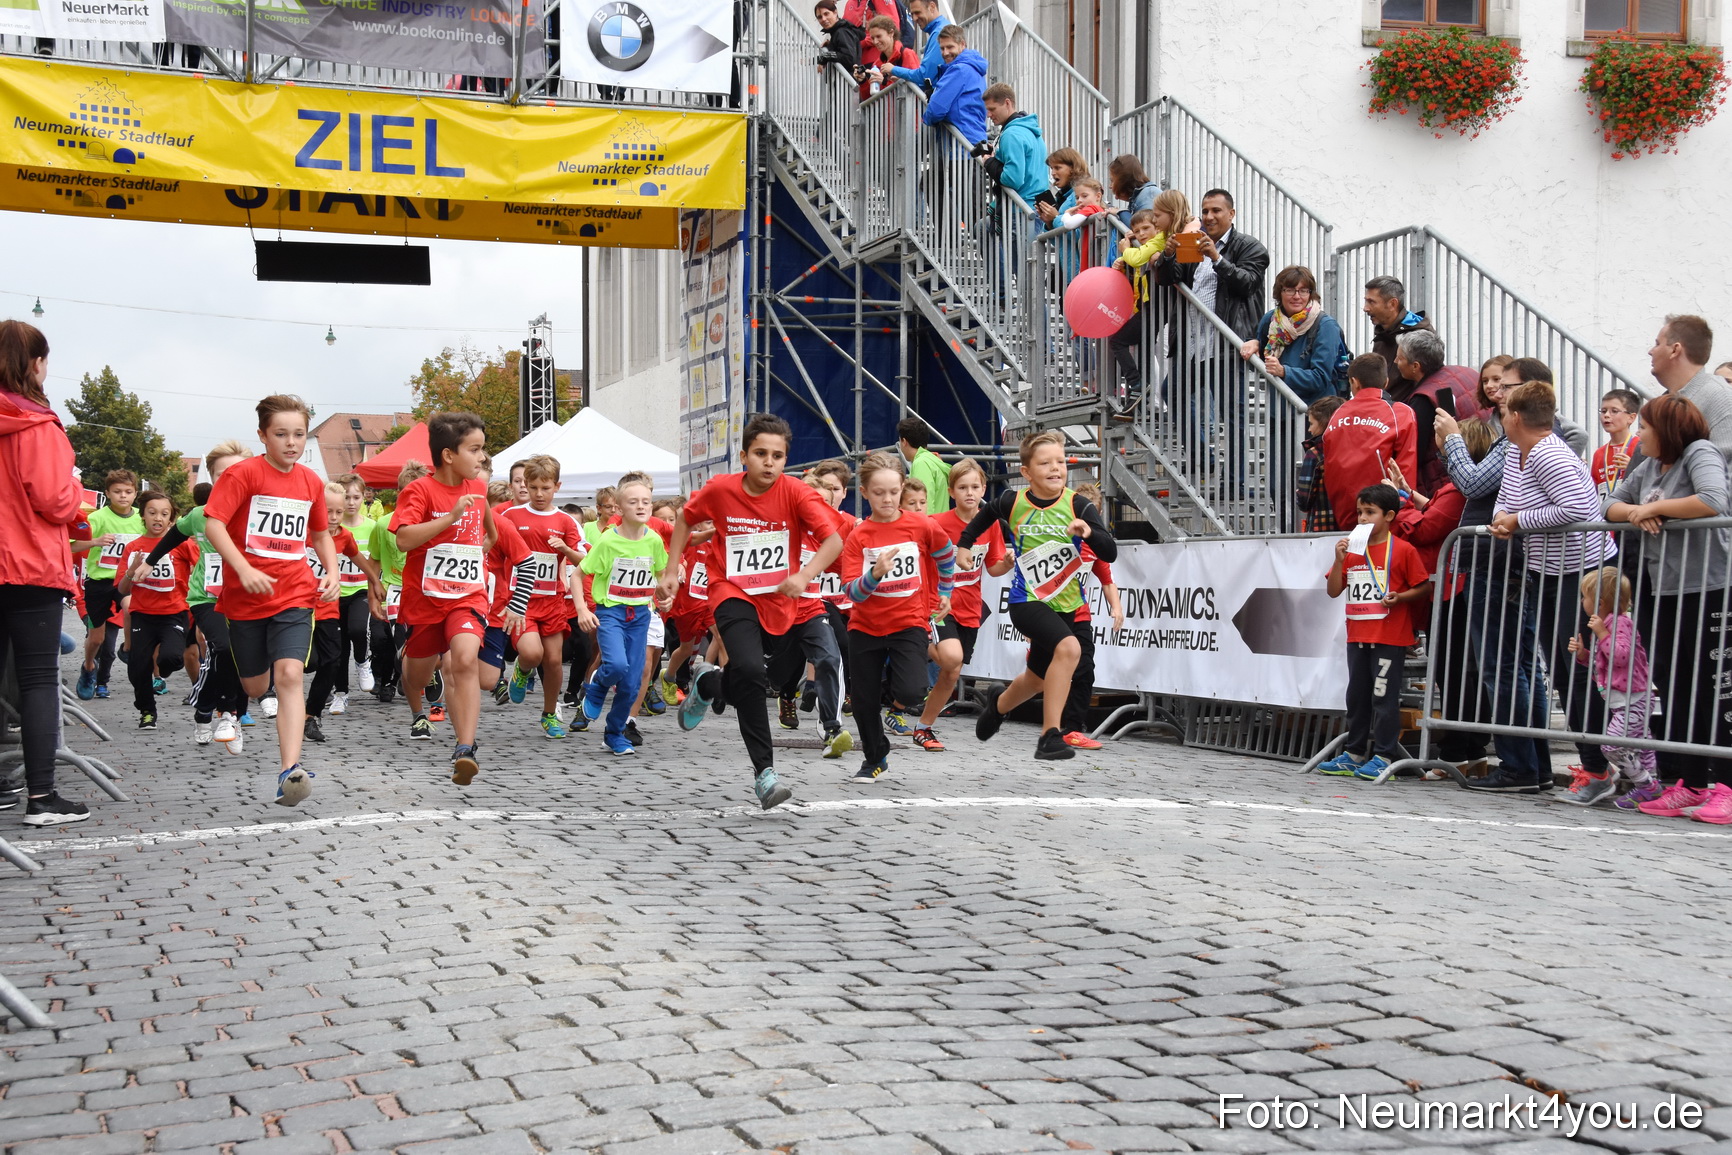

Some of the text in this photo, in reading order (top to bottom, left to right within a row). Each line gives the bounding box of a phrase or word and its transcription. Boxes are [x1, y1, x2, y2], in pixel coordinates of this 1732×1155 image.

[62, 1, 149, 16] NeuerMarkt
[216, 6, 230, 18] by
[264, 13, 310, 25] concepts
[382, 0, 466, 20] INDUSTRY
[593, 2, 651, 29] BMW
[352, 20, 506, 46] www.bockonline.de
[14, 116, 195, 148] Neumarkter Stadtlauf
[295, 109, 465, 178] ZIEL
[558, 160, 710, 176] Neumarkter Stadtlauf
[16, 168, 181, 193] Neumarkter Stadtlauf
[503, 202, 643, 220] Neumarkter Stadtlauf
[1338, 416, 1350, 427] FC
[1353, 416, 1390, 434] Deining
[257, 510, 305, 538] 7050
[726, 516, 769, 527] Neumarkter
[727, 525, 760, 534] Stadtlauf
[1018, 524, 1068, 538] BOCK
[267, 540, 292, 551] Julian
[433, 555, 479, 581] 7235
[733, 545, 785, 573] 7422
[1026, 547, 1072, 584] 7239
